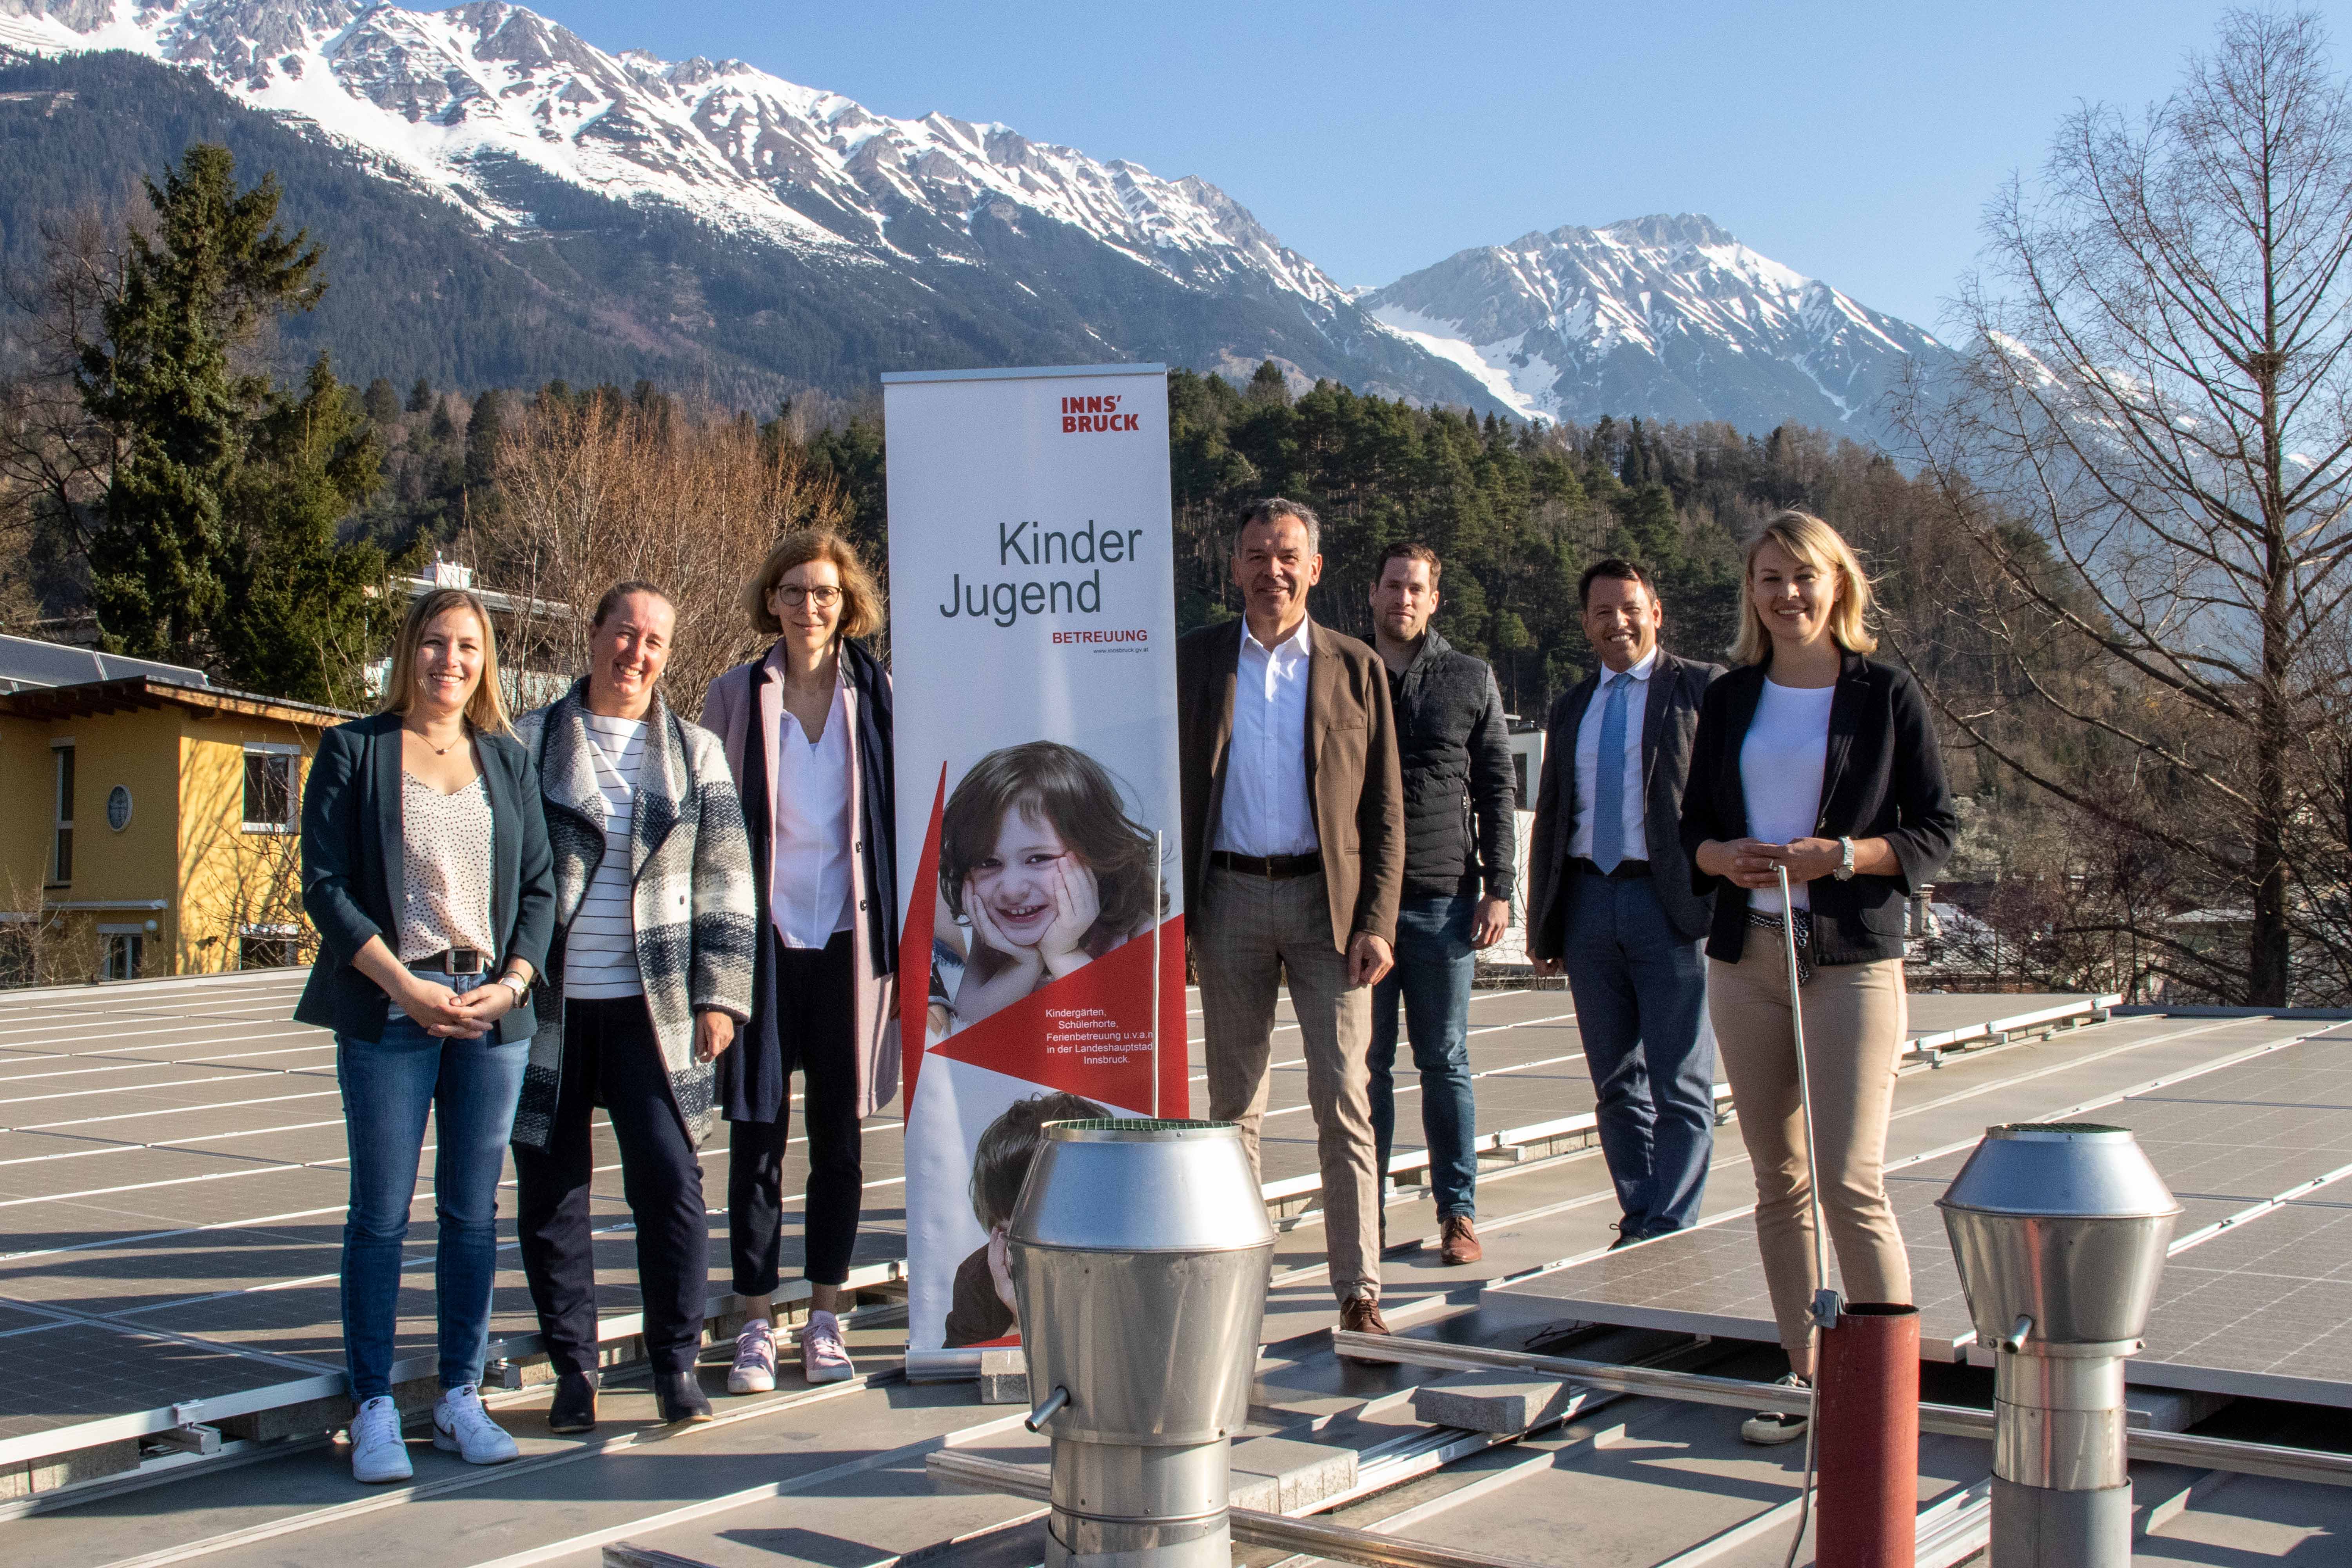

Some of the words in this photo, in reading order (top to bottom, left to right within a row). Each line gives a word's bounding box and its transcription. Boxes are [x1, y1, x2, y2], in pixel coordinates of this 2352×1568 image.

[1062, 395, 1122, 414] INNS'
[1062, 414, 1139, 433] BRUCK
[1000, 519, 1142, 565] Kinder
[940, 569, 1100, 628] Jugend
[1053, 630, 1147, 643] BETREUUNG
[1046, 1009, 1107, 1019] Kindergärten,
[1058, 1020, 1118, 1029] Schülerhorte,
[1047, 1032, 1121, 1042] Ferienbetreuung
[1047, 1045, 1055, 1053] in
[1057, 1044, 1072, 1053] der
[1075, 1042, 1153, 1053] Landeshauptstad
[1084, 1055, 1130, 1064] Innsbruck.
